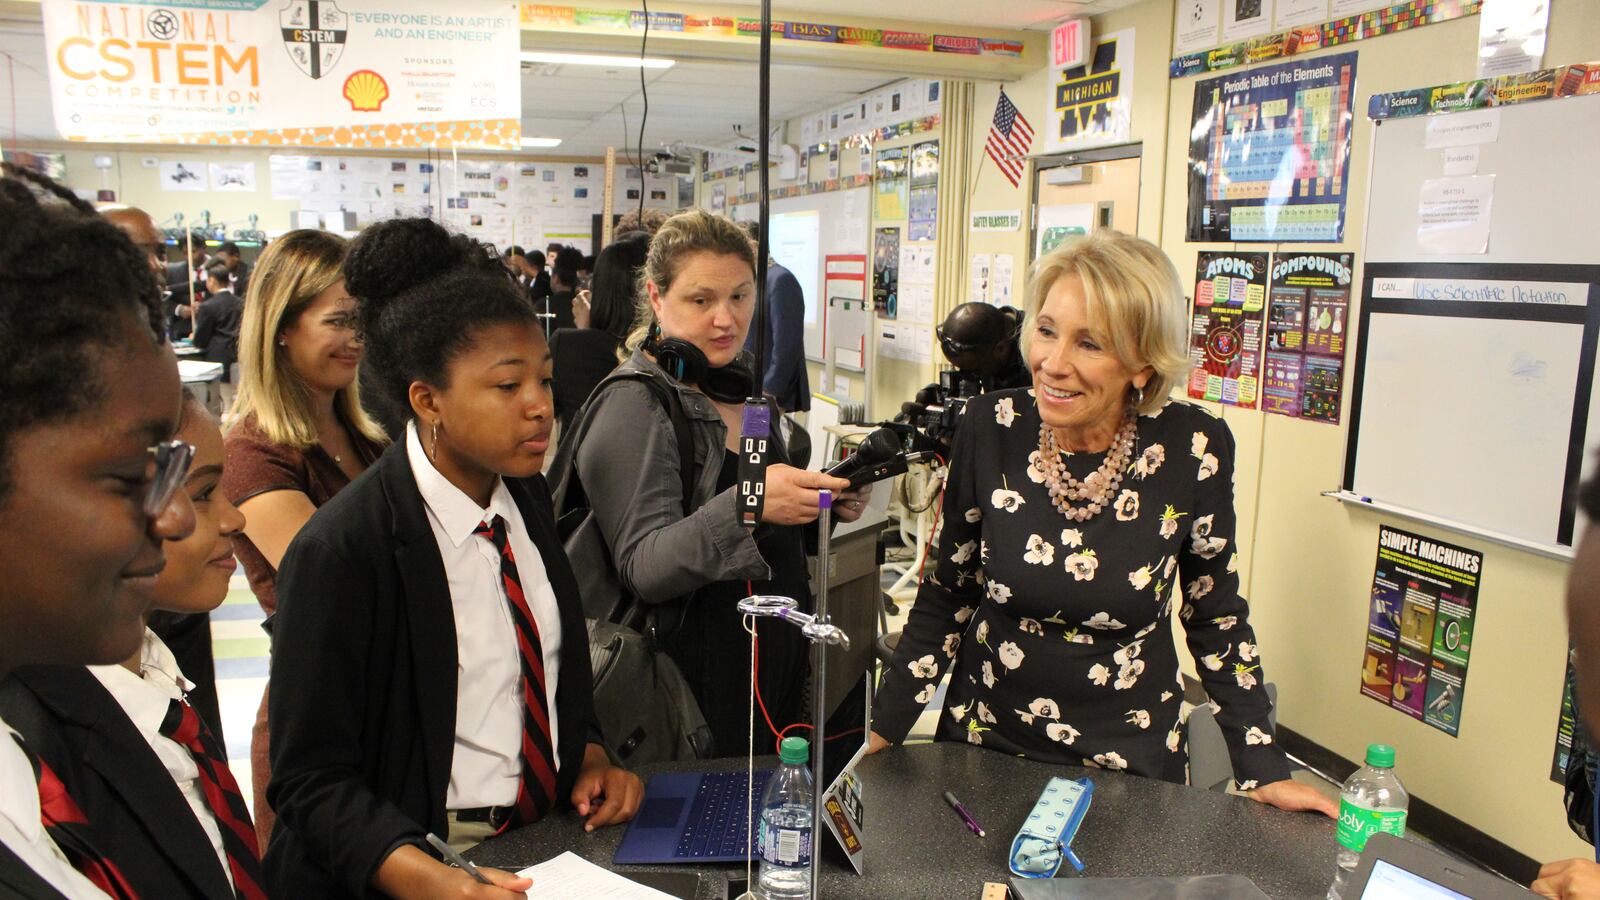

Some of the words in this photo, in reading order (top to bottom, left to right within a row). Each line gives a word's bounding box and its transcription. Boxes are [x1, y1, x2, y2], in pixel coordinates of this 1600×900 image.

[351, 12, 430, 26] "EVERYONE
[431, 14, 443, 26] IS
[445, 14, 464, 27] AN
[466, 15, 512, 29] ARTIST
[294, 29, 335, 43] CSTEM
[374, 27, 403, 39] AND
[405, 27, 426, 40] AN
[792, 23, 832, 36] BIAS
[1055, 22, 1078, 66] EXIT
[1303, 34, 1319, 43] Math
[57, 36, 260, 88] CSTEM
[404, 57, 454, 65] SPONSORS
[1182, 58, 1200, 68] Science
[1210, 57, 1236, 69] Technology
[1224, 80, 1250, 94] Periodic
[1251, 75, 1269, 89] Table
[1270, 72, 1280, 86] of
[1280, 71, 1292, 84] the
[1293, 64, 1334, 82] Elements
[64, 83, 260, 104] COMPETITION
[1062, 80, 1113, 103] MICHIGAN
[1498, 83, 1547, 99] Engineering
[1391, 96, 1417, 108] Science
[1435, 97, 1473, 109] Technology
[1205, 257, 1255, 280] ATOMS
[1272, 255, 1352, 285] COMPOUNDS
[1380, 529, 1419, 555] SIMPLE
[1418, 540, 1480, 573] MACHINES
